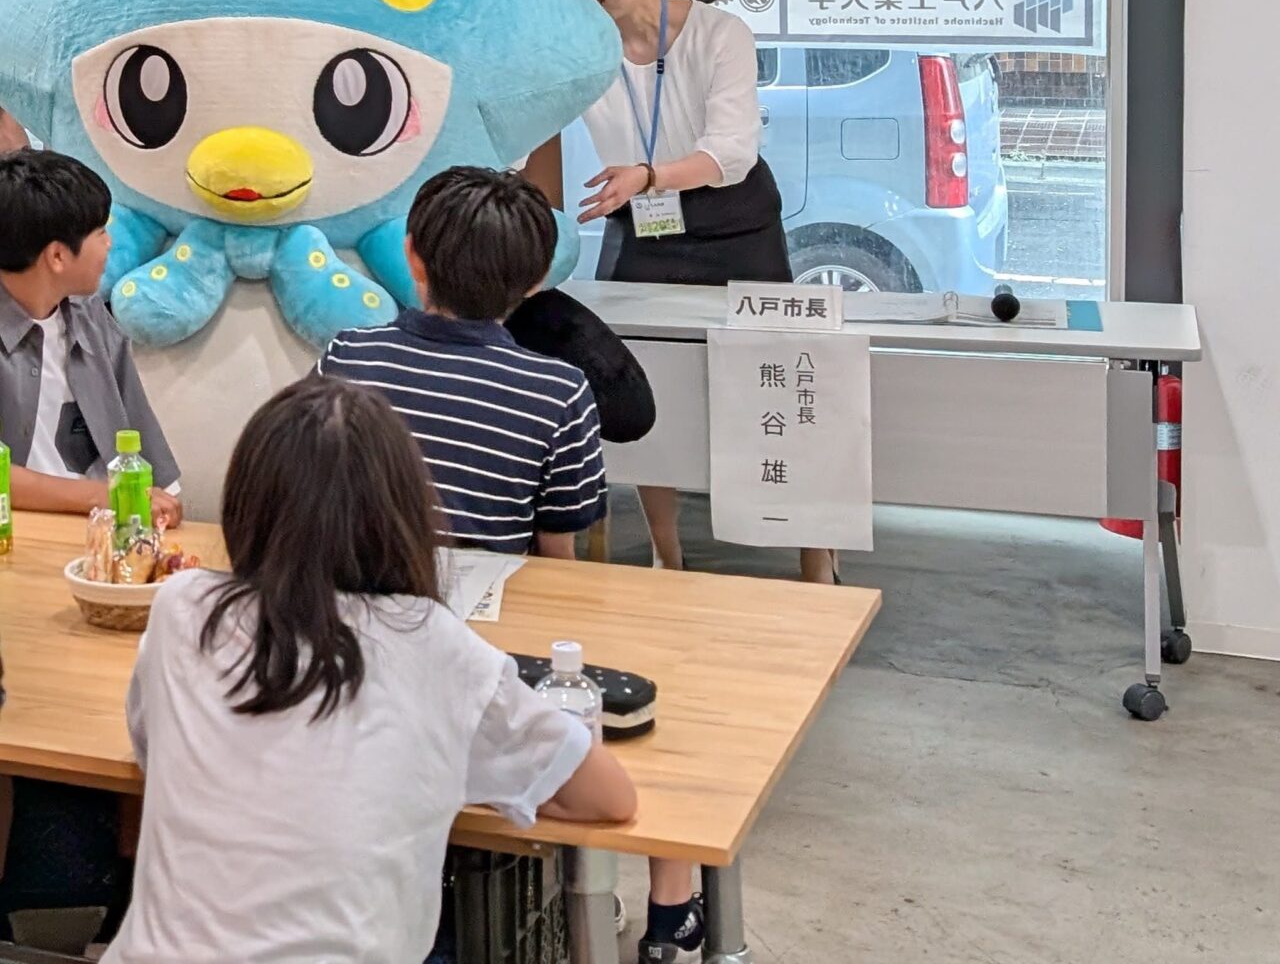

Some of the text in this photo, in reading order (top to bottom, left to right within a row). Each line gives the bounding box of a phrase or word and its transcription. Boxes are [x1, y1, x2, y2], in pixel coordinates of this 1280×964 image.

[736, 296, 827, 318] 八戸市長
[795, 352, 816, 424] 八戸市長
[759, 363, 788, 522] 熊谷雄一
